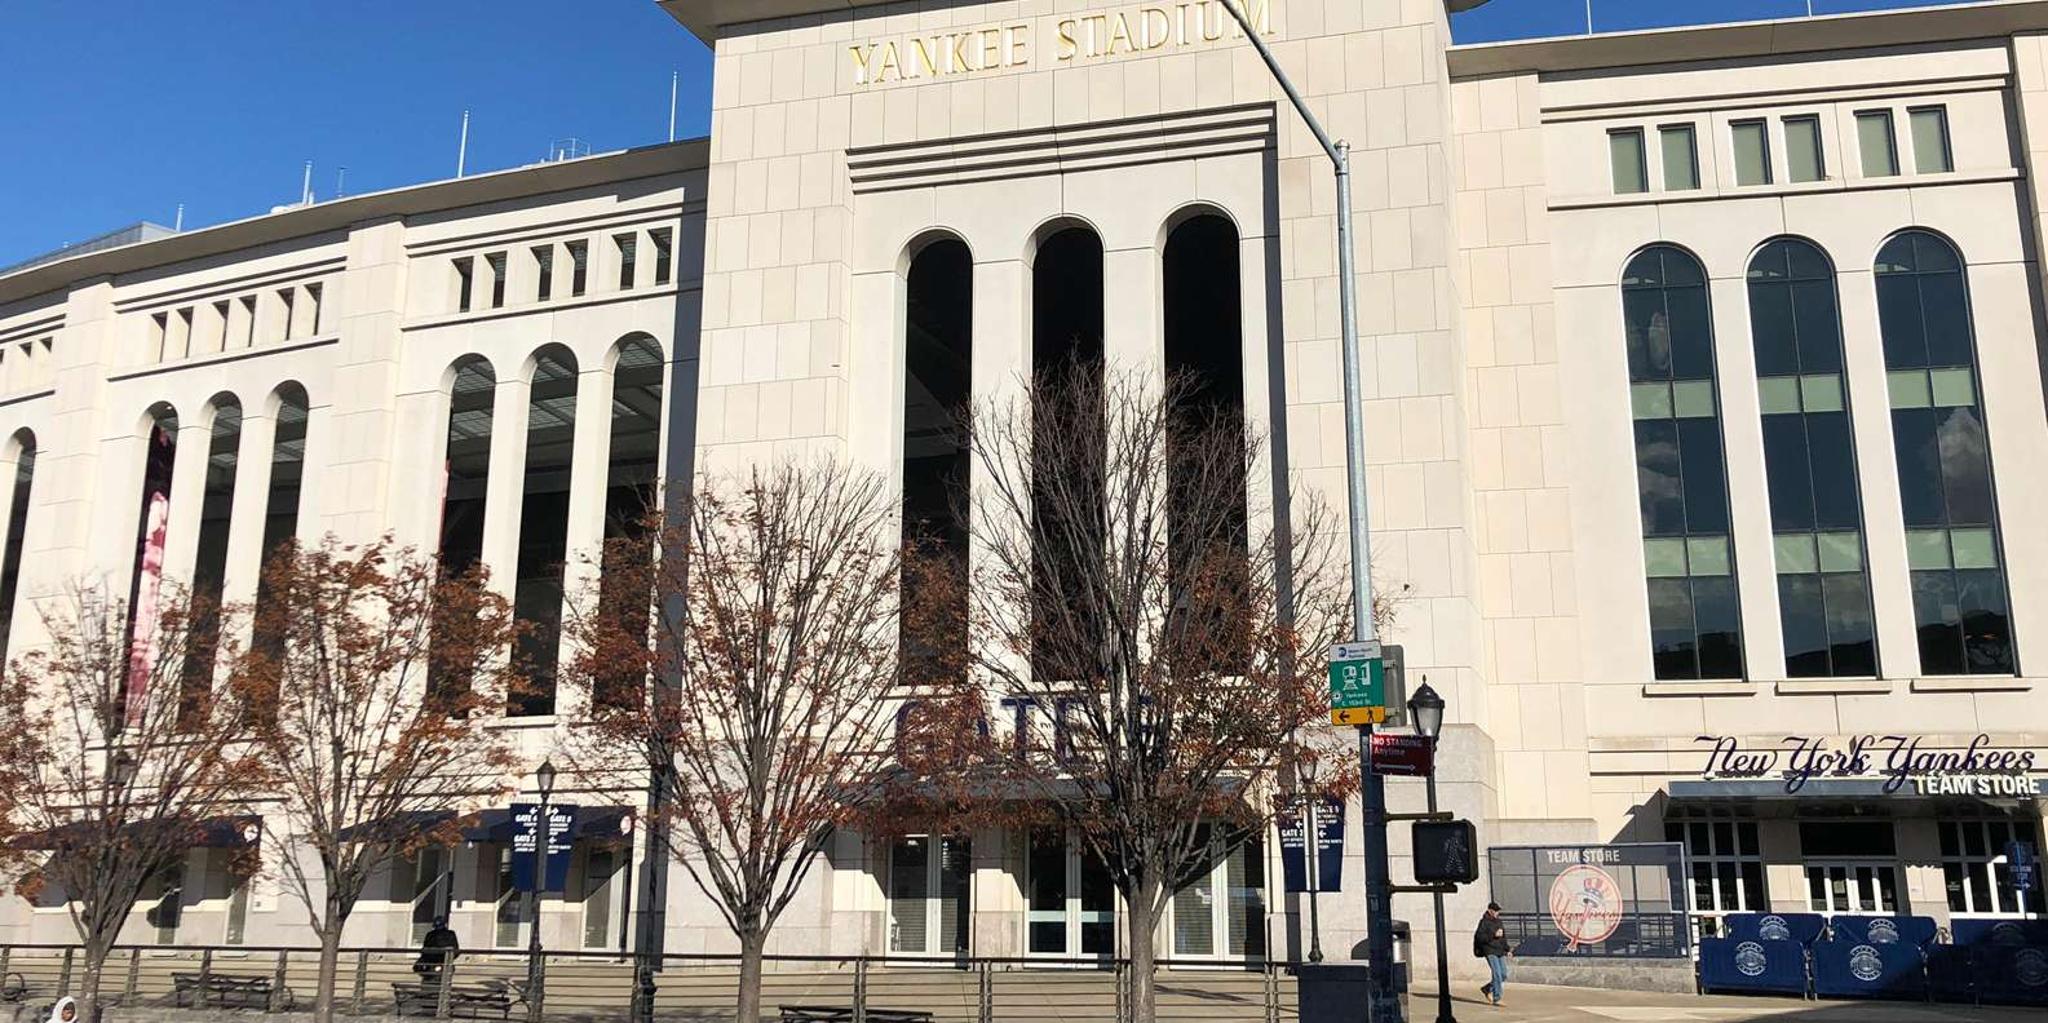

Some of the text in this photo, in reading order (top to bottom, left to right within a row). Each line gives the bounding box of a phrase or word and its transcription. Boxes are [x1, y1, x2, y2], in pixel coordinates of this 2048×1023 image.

[850, 0, 1275, 85] YANKEE STADIUM
[1373, 737, 1384, 746] NO
[1693, 733, 2036, 794] New York Yankees
[1914, 774, 2040, 796] TEAM STORE
[1281, 829, 1298, 837] GATE
[1547, 849, 1621, 863] TEAM STORE
